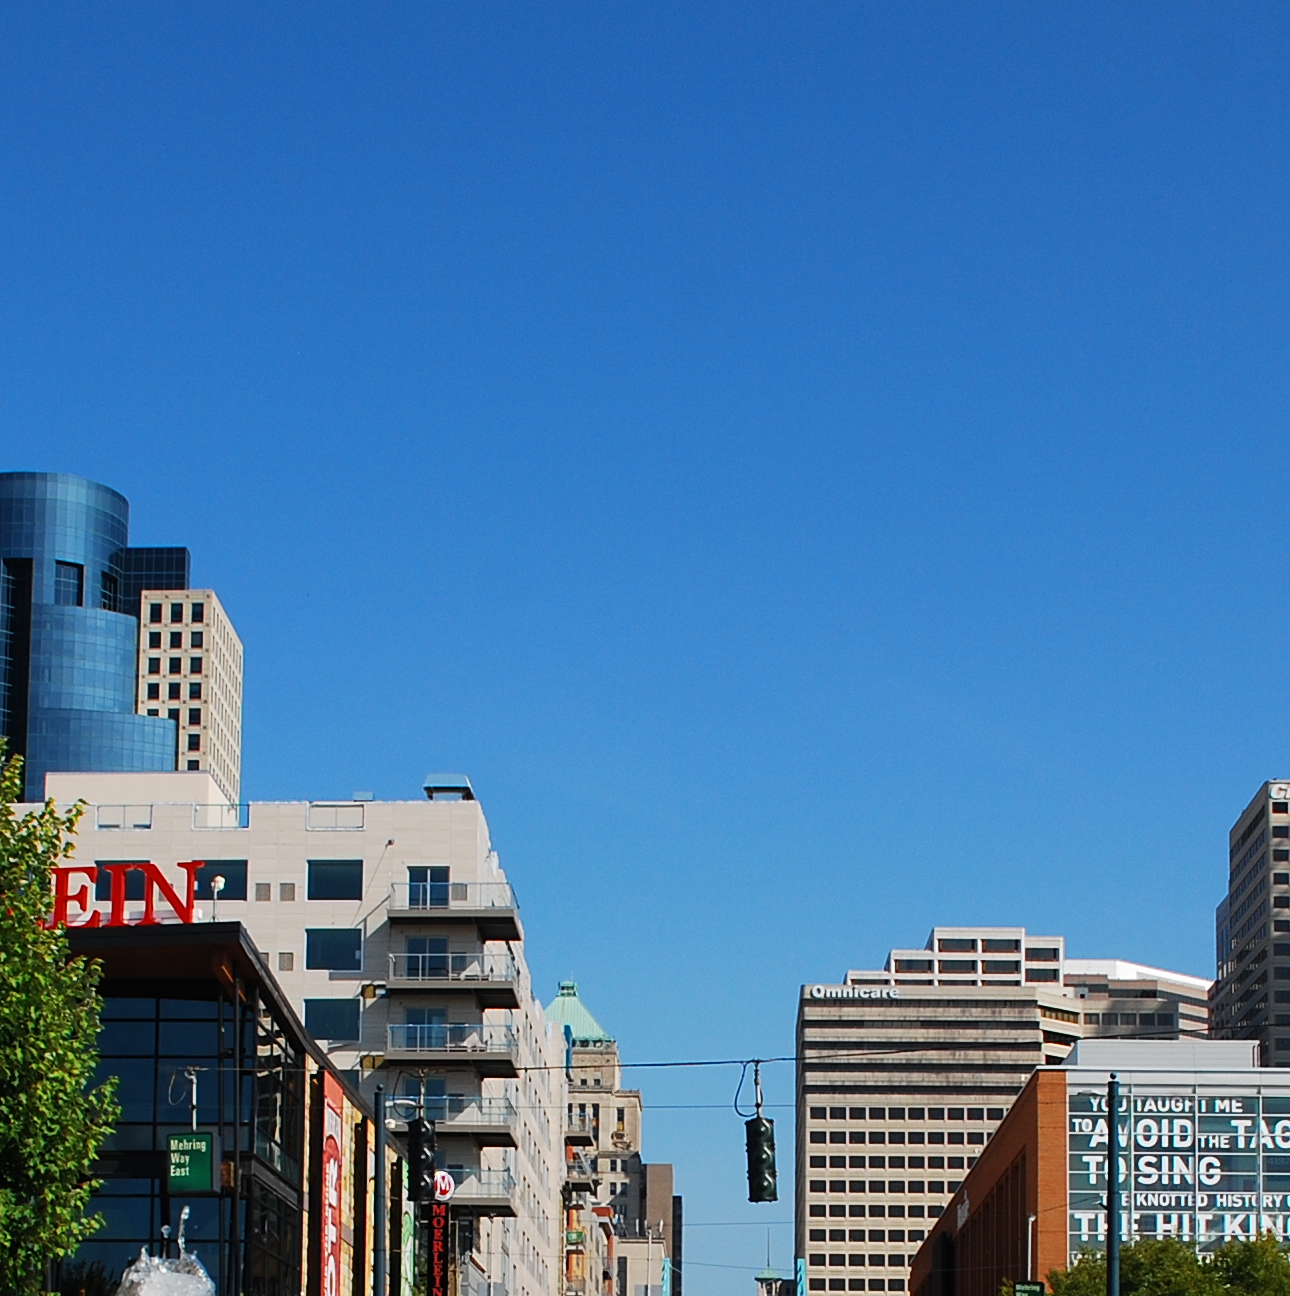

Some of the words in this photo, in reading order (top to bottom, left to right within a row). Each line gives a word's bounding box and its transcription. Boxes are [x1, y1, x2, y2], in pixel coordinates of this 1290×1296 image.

[42, 861, 206, 930] EIN
[811, 984, 900, 999] Omnicare
[1134, 1096, 1209, 1112] TAUGHT
[1214, 1098, 1244, 1113] ME
[1071, 1118, 1093, 1133] TO
[1089, 1118, 1194, 1148] AVOID
[1198, 1135, 1230, 1149] THE
[170, 1139, 207, 1153] Mehring
[170, 1152, 190, 1166] Way
[170, 1165, 190, 1177] East
[1137, 1155, 1222, 1185] SING
[1099, 1193, 1129, 1207] TE
[1136, 1193, 1208, 1207] KNOTTED
[1216, 1194, 1284, 1208] HISTORY
[1156, 1213, 1213, 1242] HIT
